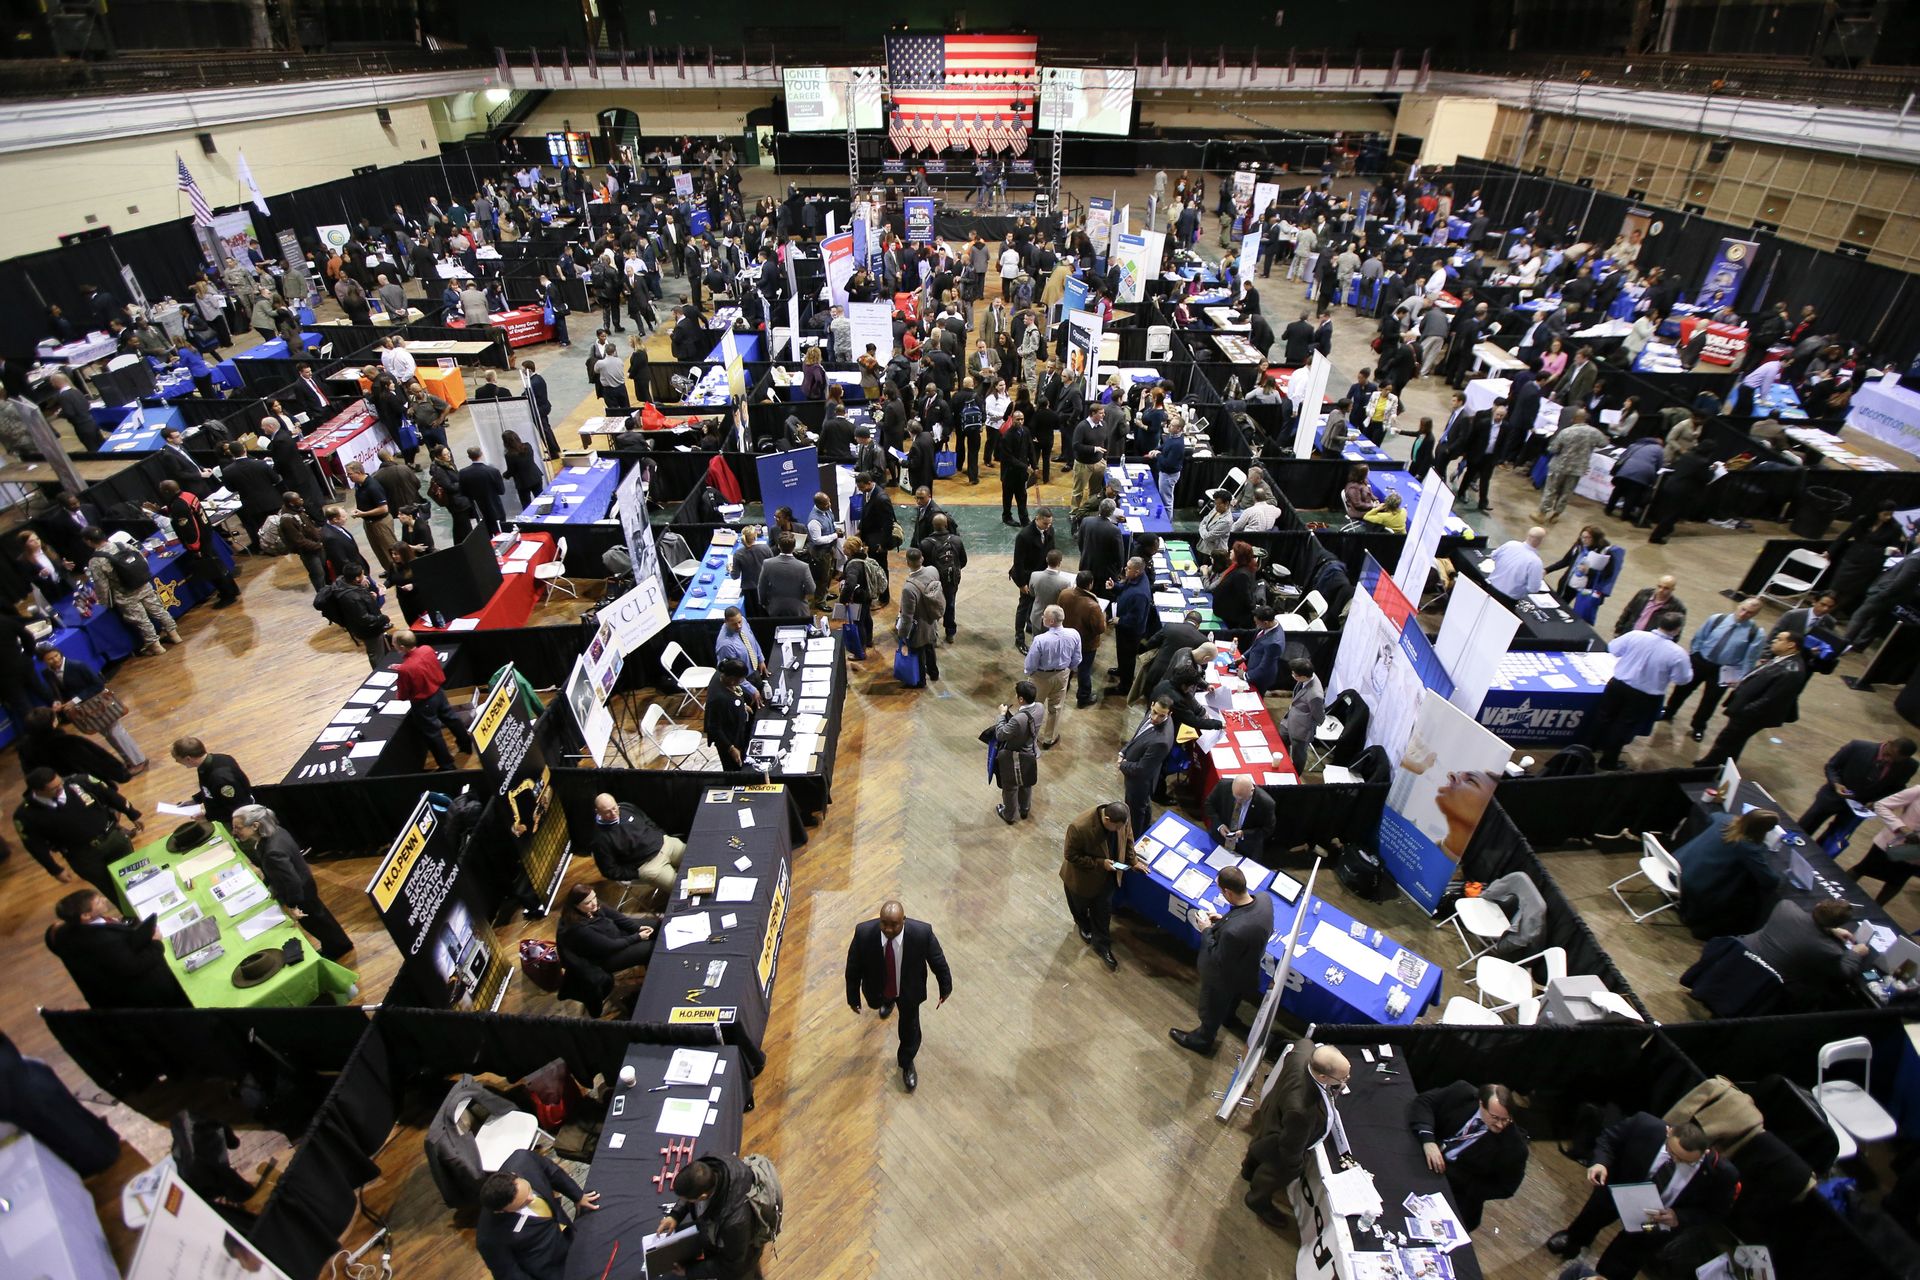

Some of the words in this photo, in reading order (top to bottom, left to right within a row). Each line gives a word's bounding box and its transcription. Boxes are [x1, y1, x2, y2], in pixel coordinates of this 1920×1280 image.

[785, 70, 820, 79] IGNITE
[786, 80, 820, 91] YOUR
[787, 92, 821, 100] CAREER
[515, 322, 527, 330] Army
[515, 326, 535, 334] Engineers
[481, 694, 506, 736] H.O.PENN
[494, 714, 515, 746] ETHICAL
[1480, 707, 1513, 726] VA
[1529, 709, 1585, 728] VETS
[497, 721, 526, 771] INNOVATION
[498, 722, 519, 756] SUCCESS
[504, 735, 524, 770] QUALITY
[499, 729, 535, 796] COMMUNICATION
[383, 832, 419, 892] H.O.PENN
[418, 810, 434, 835] CAT
[1404, 836, 1419, 851] water
[404, 853, 433, 898] ETHICAL
[408, 859, 437, 907] SUCCESS
[408, 858, 446, 926] INNOVATION
[411, 863, 460, 955] COMMUNICATION
[418, 876, 444, 923] QUALITY
[679, 1010, 716, 1018] H.O.PENN
[719, 1011, 734, 1019] CAT
